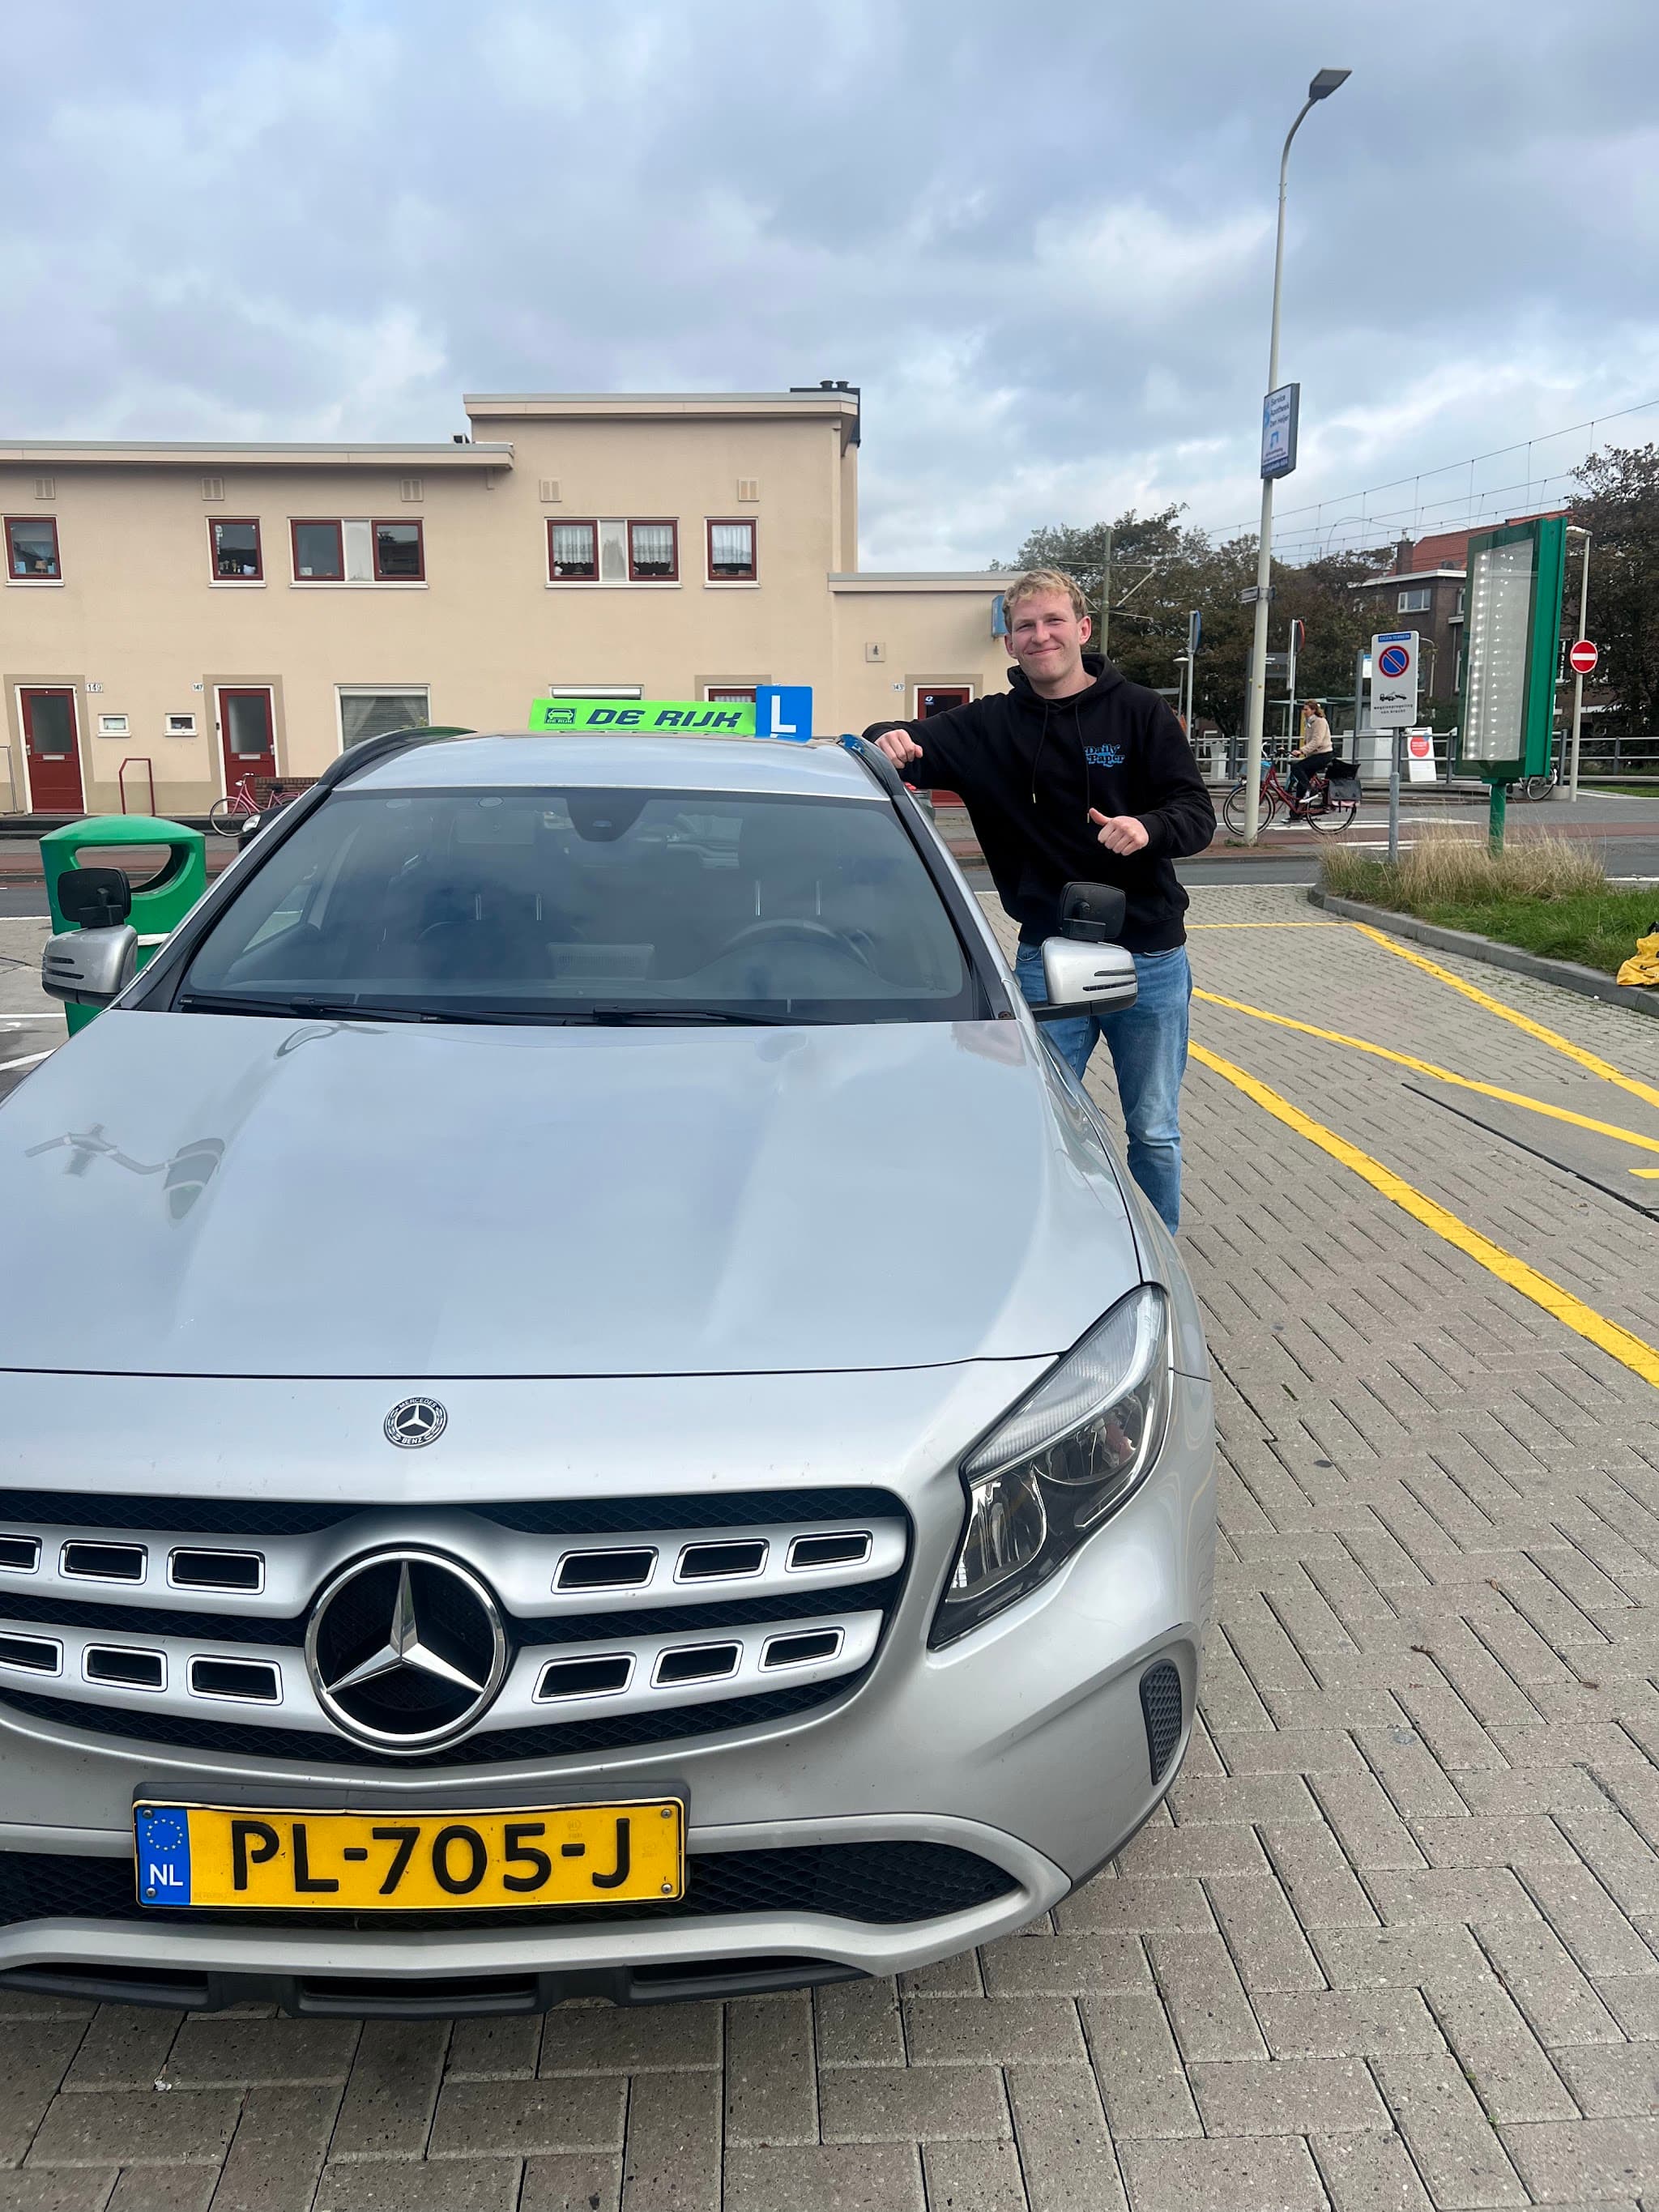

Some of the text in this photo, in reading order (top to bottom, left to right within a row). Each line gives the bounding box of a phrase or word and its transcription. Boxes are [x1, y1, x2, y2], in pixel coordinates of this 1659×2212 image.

[586, 710, 744, 727] DE RIJK
[771, 695, 797, 733] L
[1085, 744, 1121, 757] Daily
[1086, 754, 1125, 768] Paper
[399, 1398, 437, 1409] MERCEDES
[232, 1818, 630, 1895] PL-705-J
[149, 1863, 184, 1887] NL
